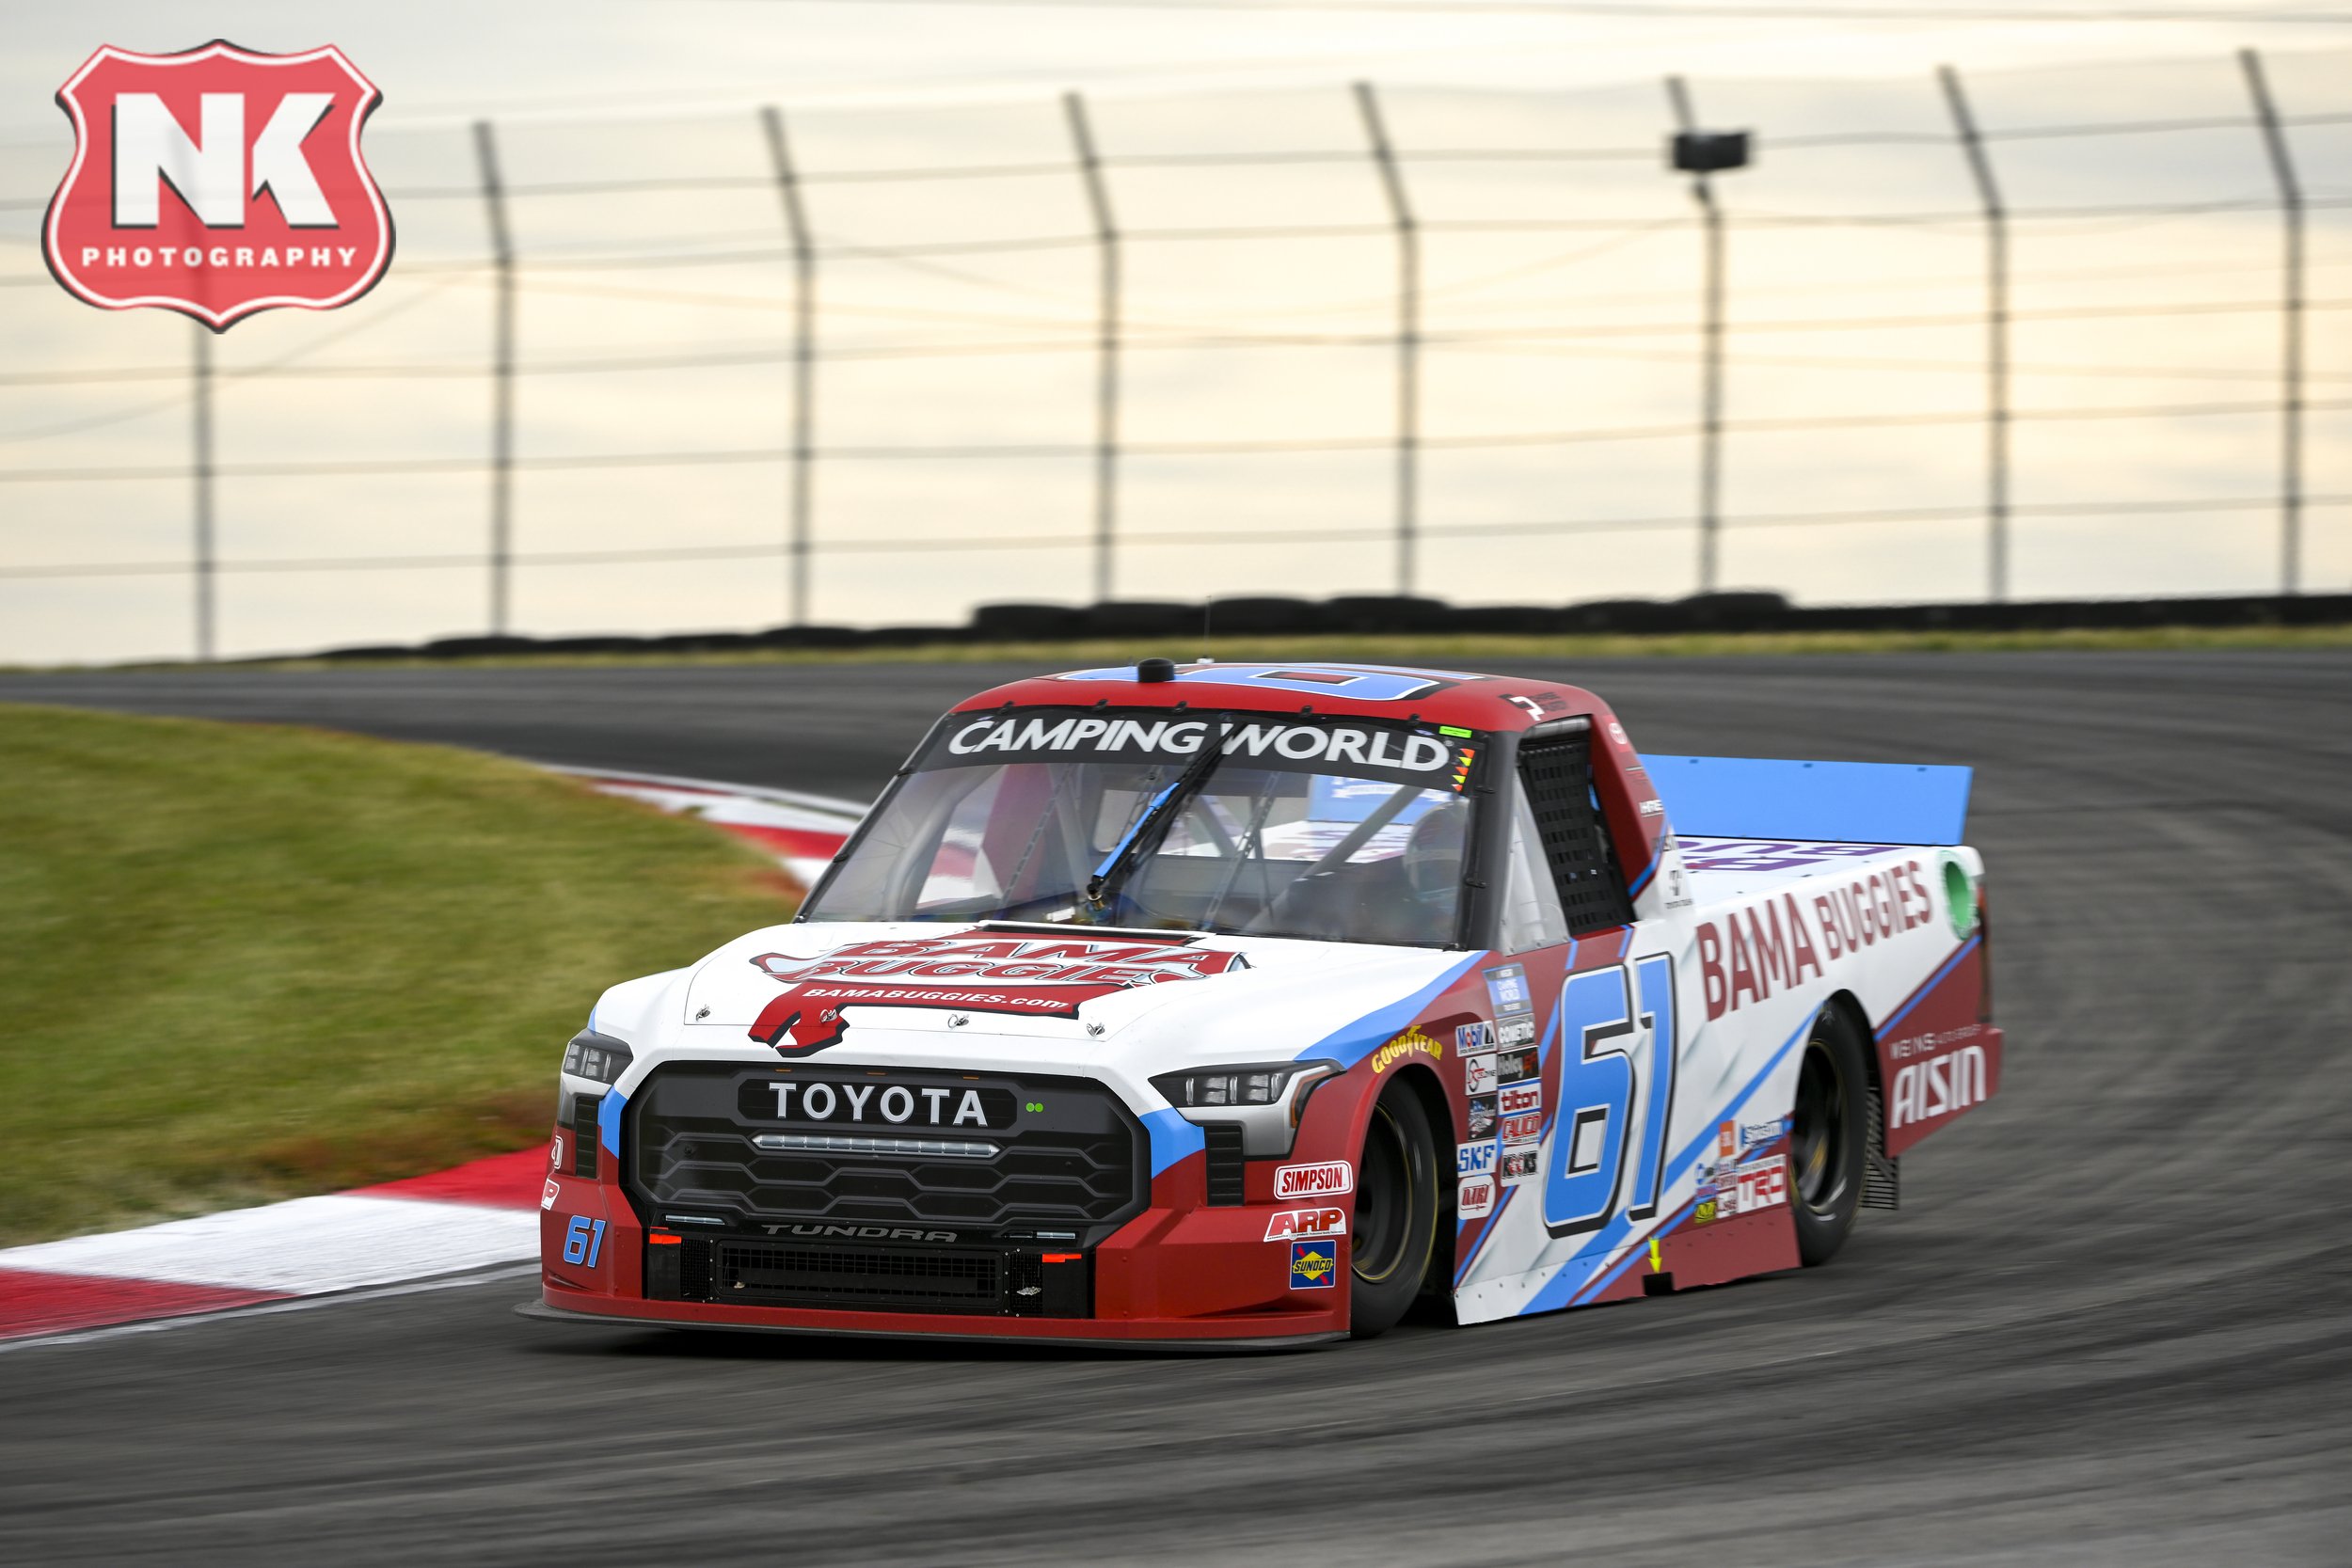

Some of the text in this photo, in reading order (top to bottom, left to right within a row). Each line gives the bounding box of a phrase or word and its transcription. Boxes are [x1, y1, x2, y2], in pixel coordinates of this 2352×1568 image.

[948, 718, 1450, 772] CAMPING WORLD
[832, 939, 1248, 976] BAMA
[1696, 861, 1933, 1022] BAMA BUGGIES
[802, 989, 1071, 1009] BAMABUGGIES.com
[1372, 1025, 1443, 1073] GOODYEAR
[769, 1082, 989, 1127] TOYOTA
[1544, 952, 1677, 1239] 61
[1890, 1045, 1987, 1129] AISIN
[1281, 1166, 1343, 1194] SIMPSON
[1457, 1144, 1495, 1173] SKF
[1738, 1164, 1787, 1209] TRD
[563, 1214, 607, 1268] 61
[760, 1224, 958, 1243] TUNDRA
[1268, 1210, 1343, 1237] ARP
[1293, 1259, 1334, 1273] SUNOCO
